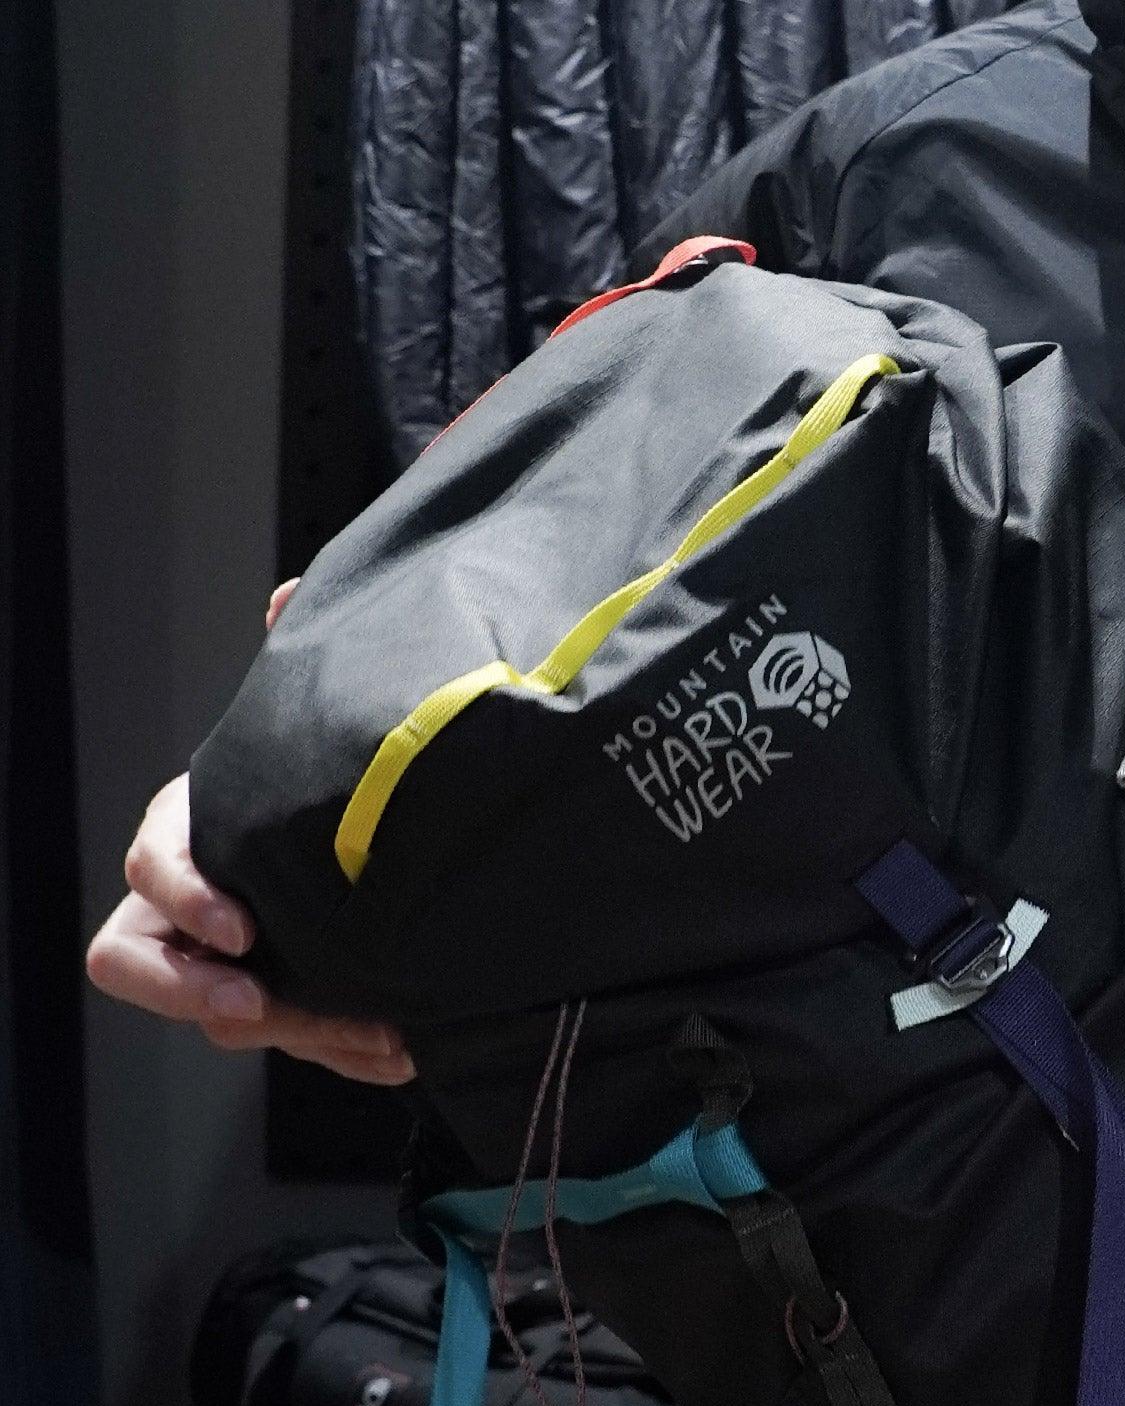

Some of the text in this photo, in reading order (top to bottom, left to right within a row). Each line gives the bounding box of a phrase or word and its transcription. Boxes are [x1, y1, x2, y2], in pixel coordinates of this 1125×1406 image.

[602, 594, 788, 761] MOUNTAIN
[625, 691, 748, 807] HARD
[656, 724, 793, 843] WEAR
